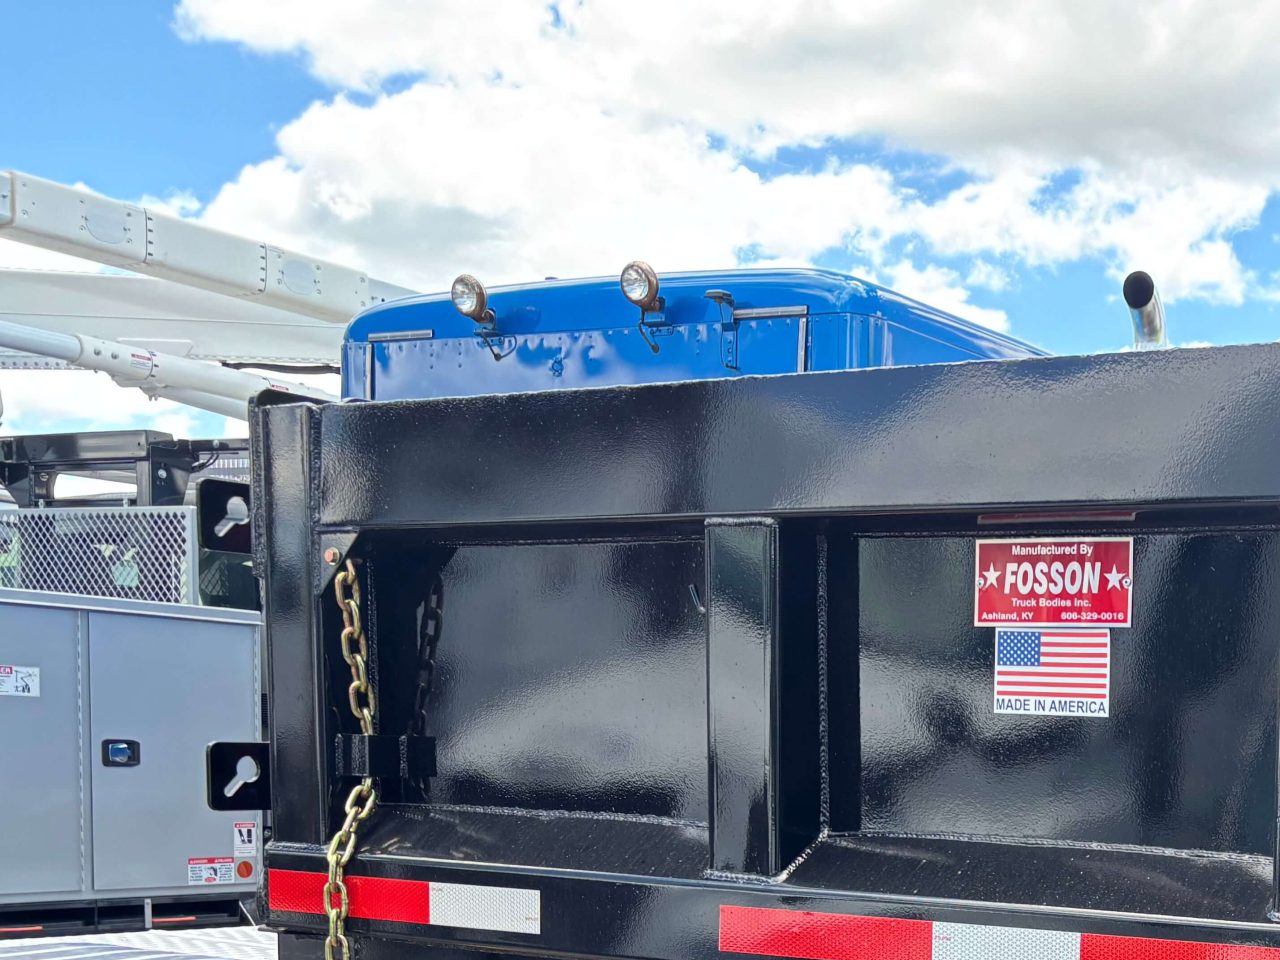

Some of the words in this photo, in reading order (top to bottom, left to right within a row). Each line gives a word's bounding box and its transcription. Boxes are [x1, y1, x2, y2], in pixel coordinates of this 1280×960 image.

[1012, 545, 1077, 555] Manufactured
[1080, 544, 1093, 557] By
[1003, 561, 1102, 595] FOSSON
[1011, 598, 1036, 607] Truck
[1039, 598, 1071, 607] Bodies
[1074, 598, 1092, 607] Inc.
[981, 612, 1019, 621] Ashland,
[1022, 611, 1033, 620] KY
[1060, 612, 1124, 620] 606-329-0016
[996, 698, 1030, 711] MADE
[1034, 699, 1046, 712] IN
[1050, 700, 1106, 714] AMERICA
